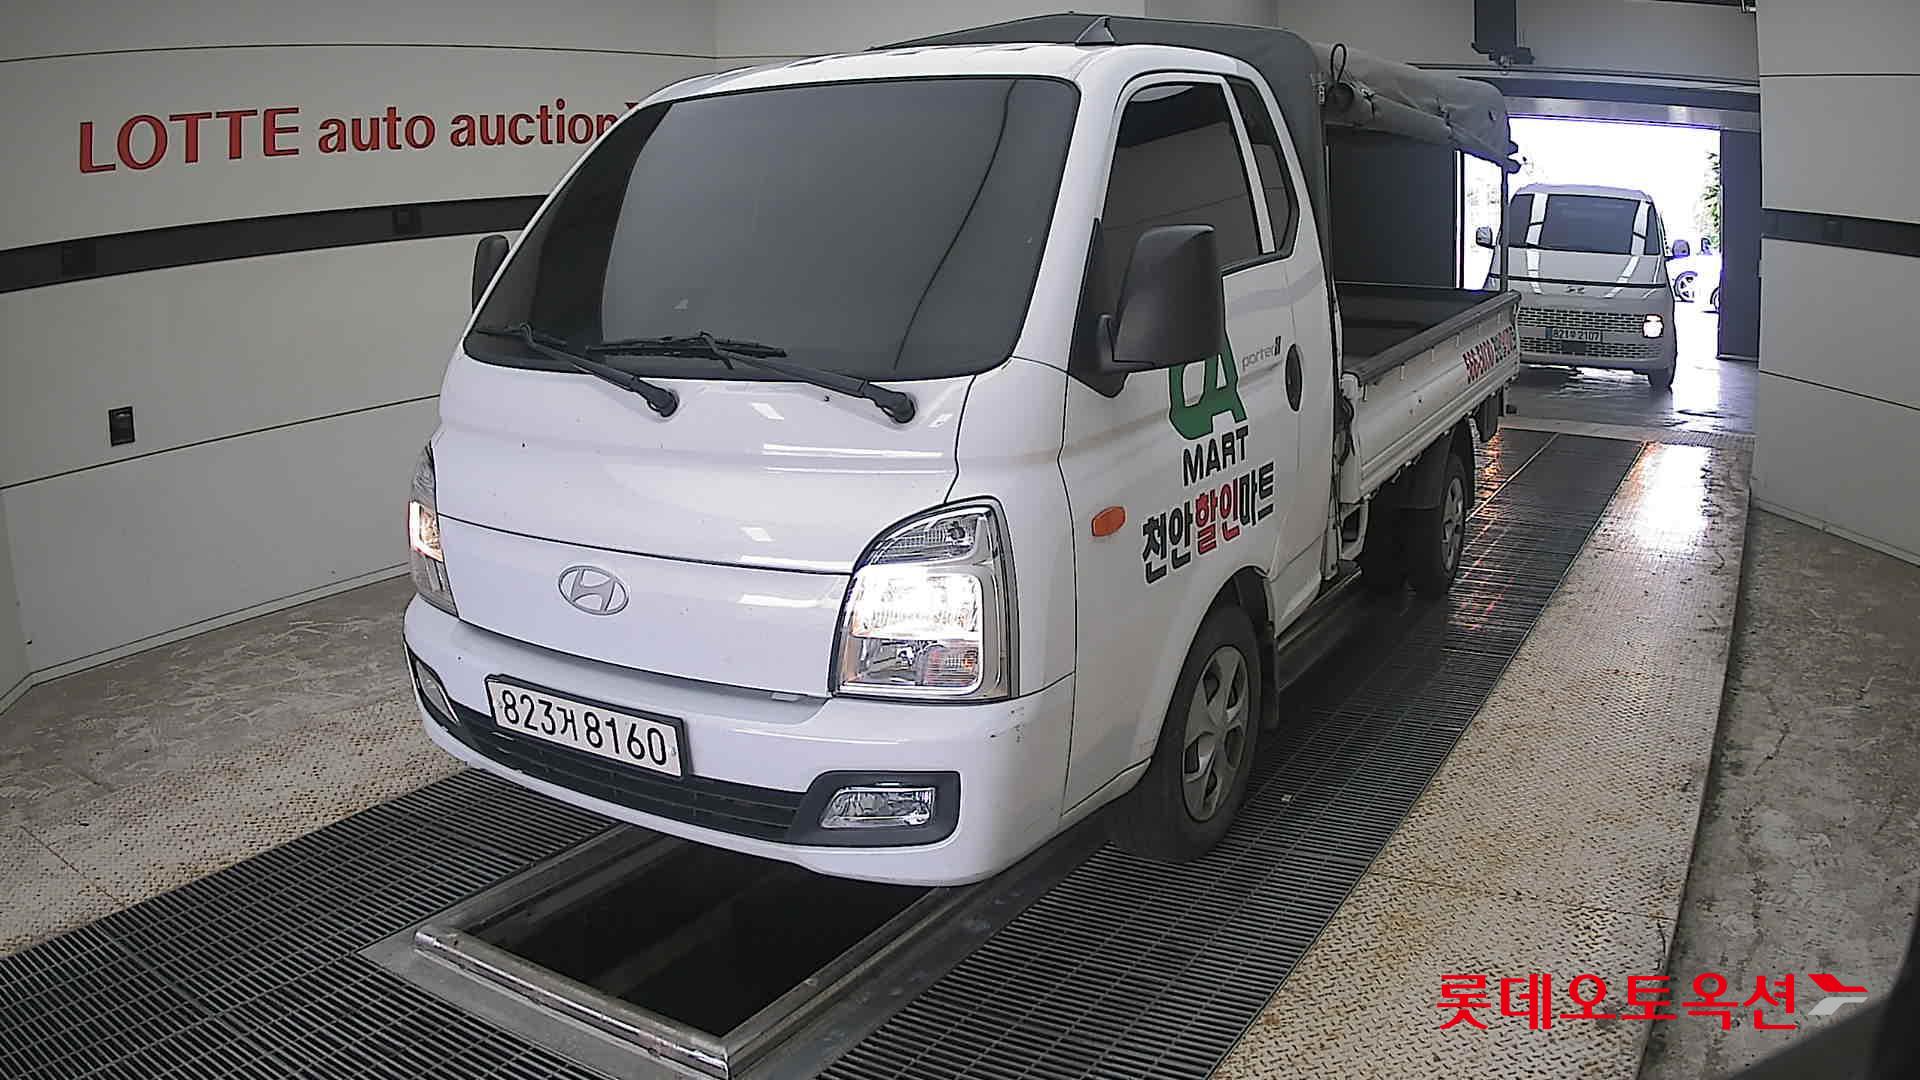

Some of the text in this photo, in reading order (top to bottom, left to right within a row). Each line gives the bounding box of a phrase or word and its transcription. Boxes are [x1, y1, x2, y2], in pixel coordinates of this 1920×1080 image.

[79, 107, 300, 173] LOTTE
[317, 105, 436, 153] auto
[1183, 425, 1249, 486] MART
